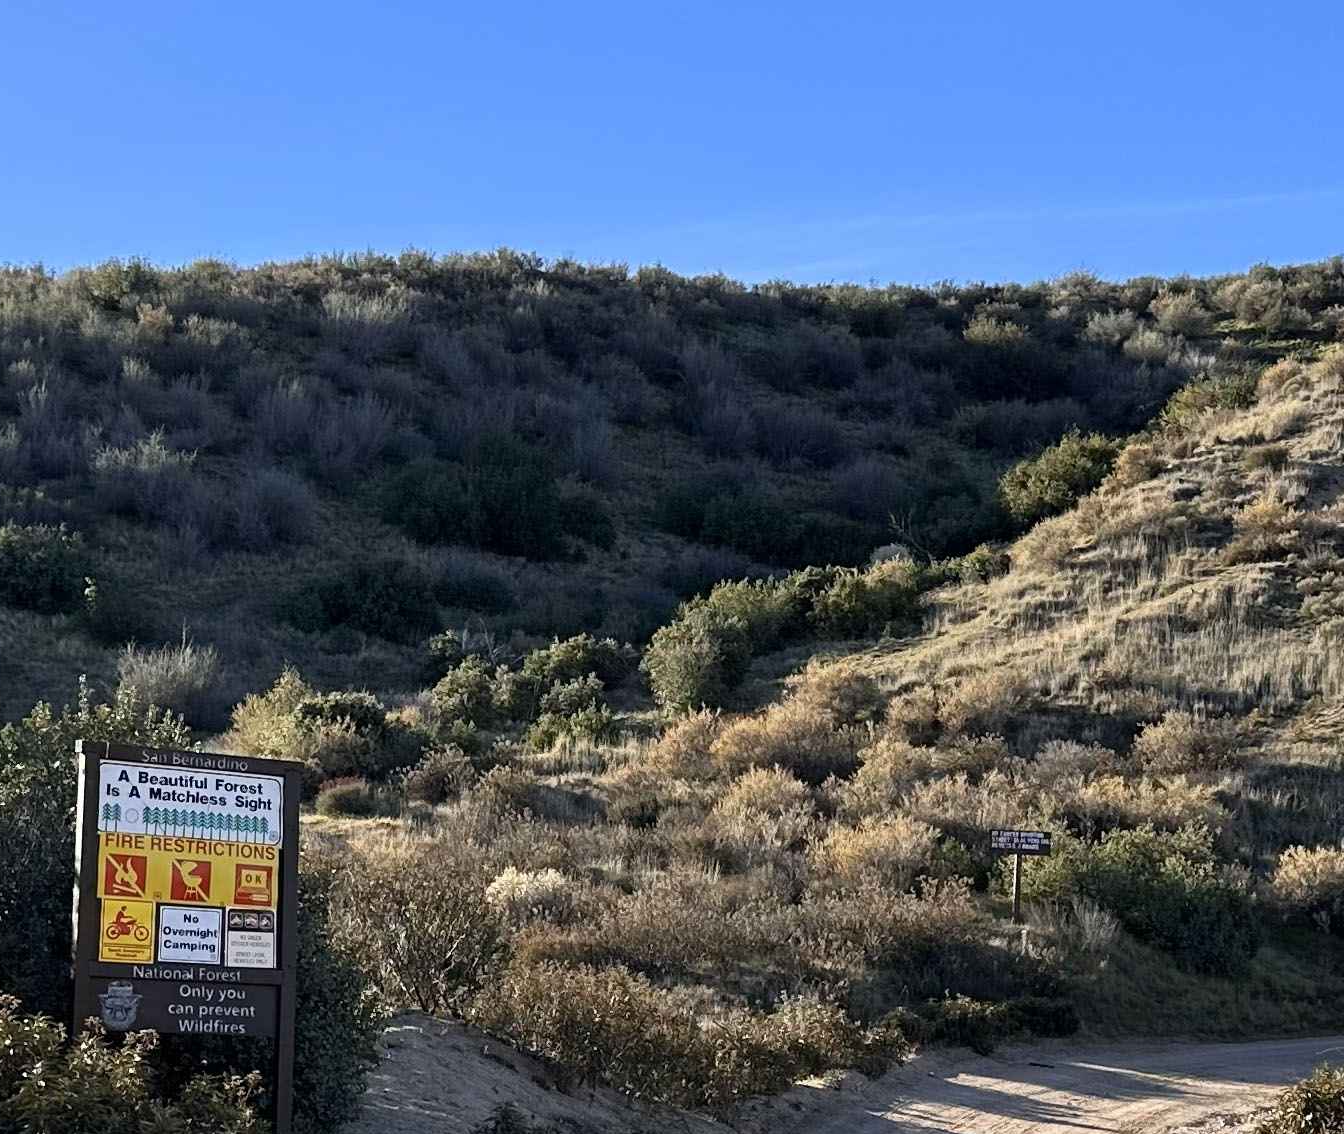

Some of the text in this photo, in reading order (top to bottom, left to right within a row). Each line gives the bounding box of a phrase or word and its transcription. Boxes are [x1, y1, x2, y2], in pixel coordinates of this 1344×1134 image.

[142, 751, 249, 771] San Bernardino
[118, 770, 263, 795] A Beautiful Forest
[106, 784, 272, 812] Is A Matchless Sight
[105, 832, 275, 860] FIRE RESTRICTIONS
[183, 914, 199, 924] No
[163, 927, 218, 939] Overnight
[163, 940, 216, 953] Camping
[133, 966, 241, 982] National Forest
[179, 984, 246, 1001] Only you
[168, 1003, 256, 1018] can prevent
[178, 1019, 246, 1034] Wildfires
